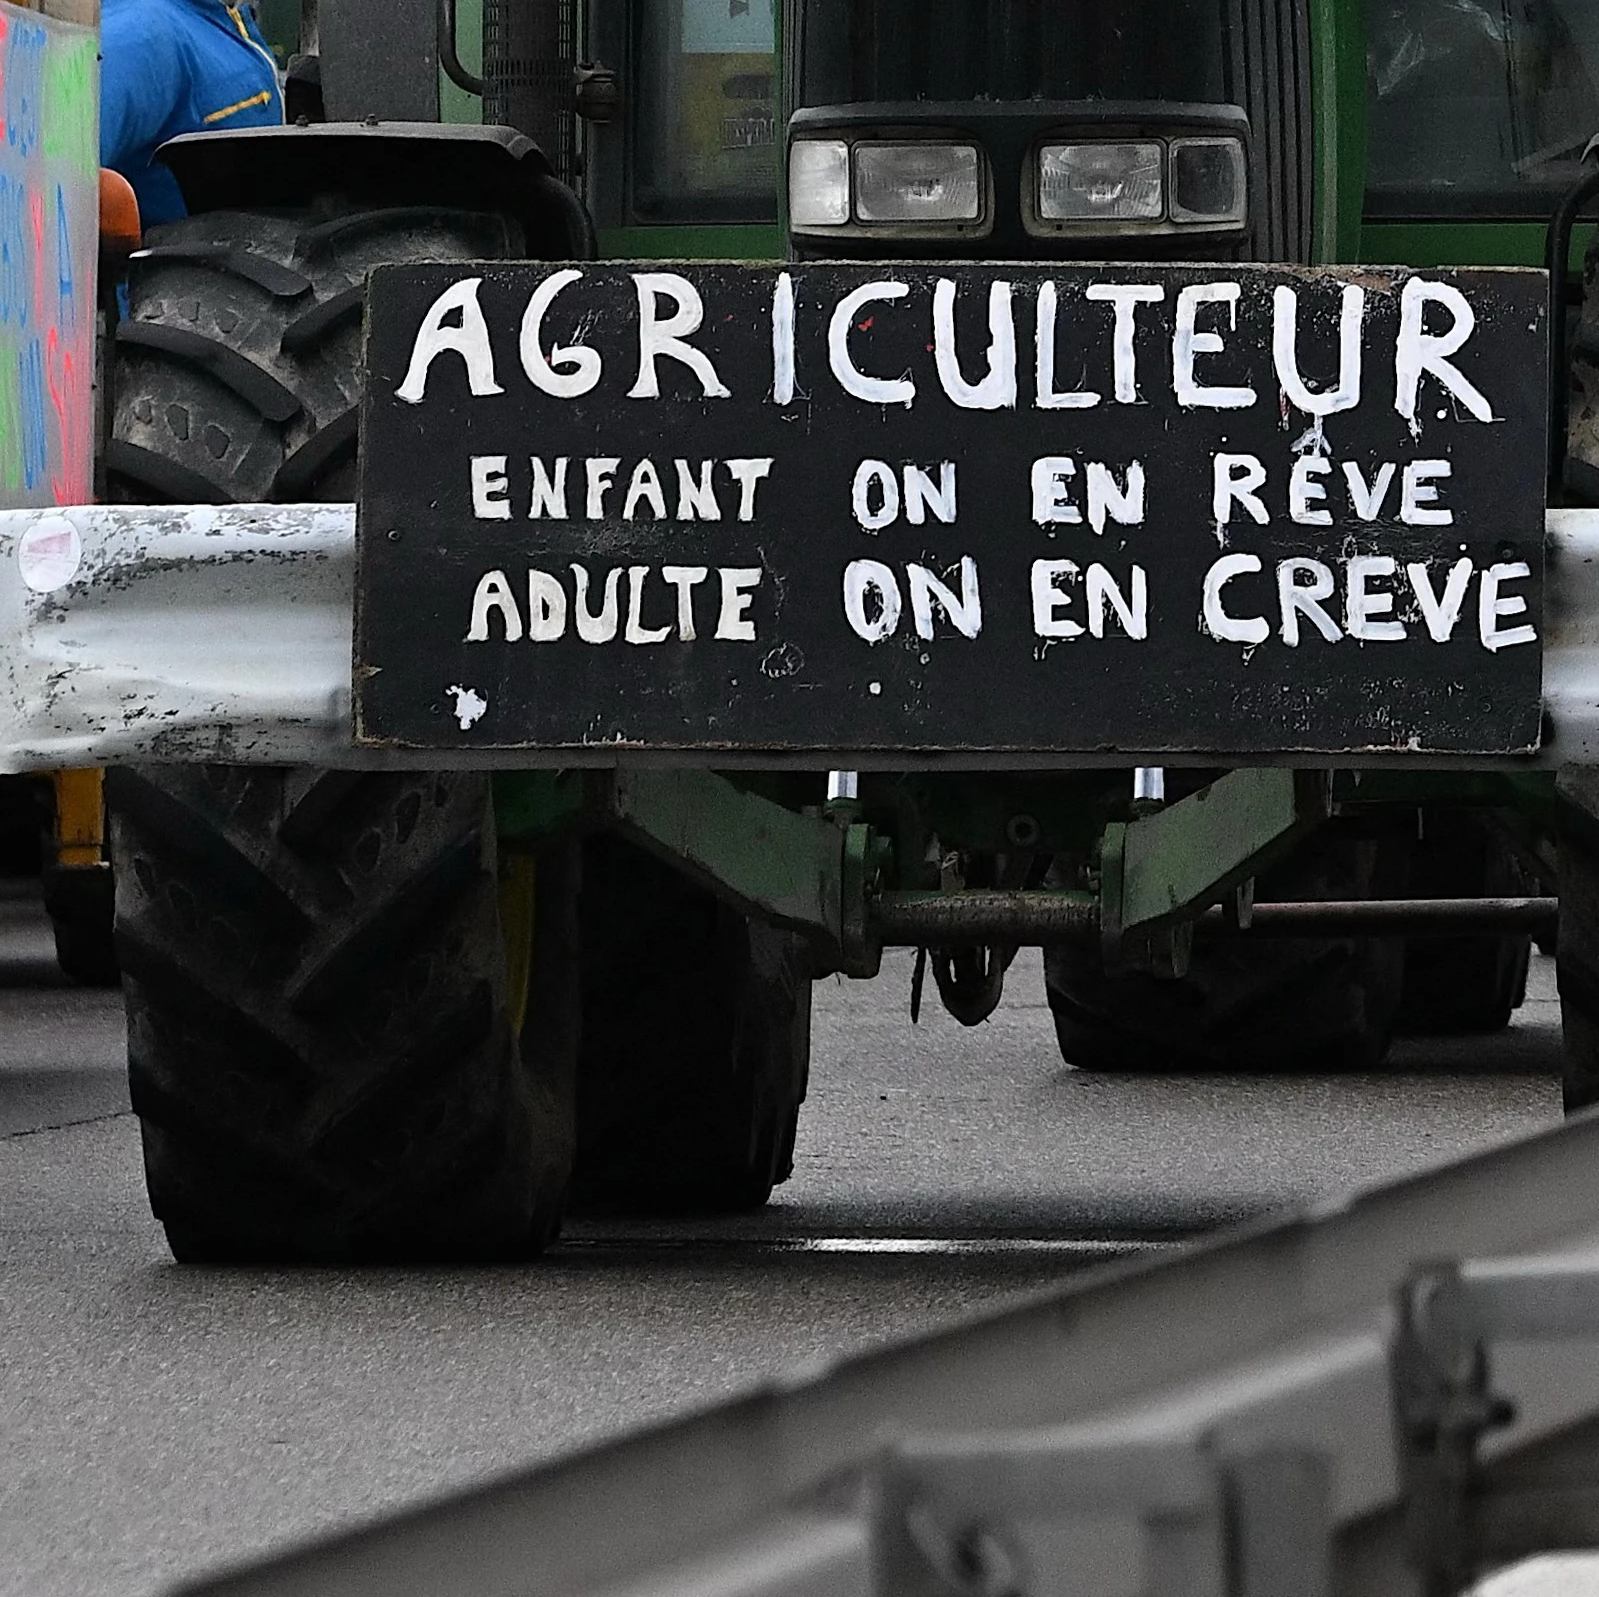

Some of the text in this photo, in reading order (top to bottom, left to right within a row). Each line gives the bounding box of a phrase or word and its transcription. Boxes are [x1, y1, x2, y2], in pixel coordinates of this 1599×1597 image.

[396, 270, 1496, 423] AGRICULTEUR
[470, 429, 1455, 534] ENFANT ON EN RÊVE
[465, 552, 1537, 652] ADULTE ON EN CREVE
